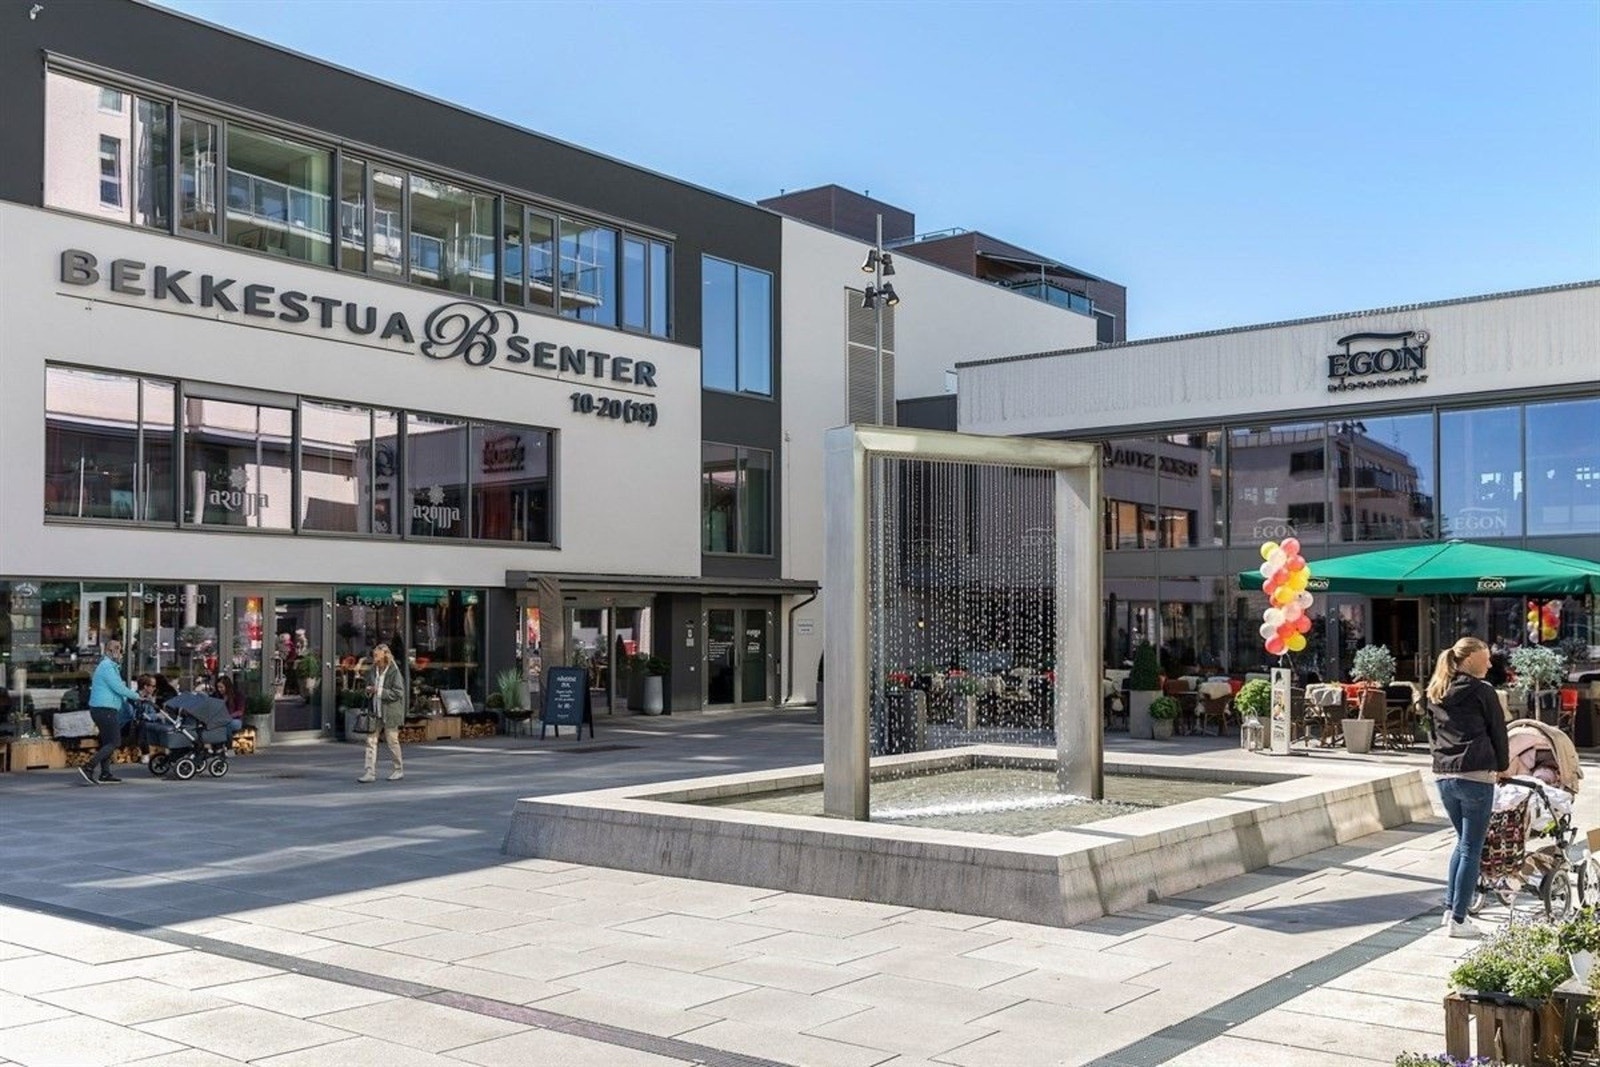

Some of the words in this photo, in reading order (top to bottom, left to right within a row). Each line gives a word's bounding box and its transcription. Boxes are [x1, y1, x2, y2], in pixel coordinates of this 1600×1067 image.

[60, 248, 415, 344] BEKKESTUA
[506, 335, 657, 387] SENTER
[1327, 345, 1428, 378] EGON
[1454, 515, 1507, 530] EGON
[1252, 525, 1299, 539] EGON
[1477, 580, 1507, 589] EGON
